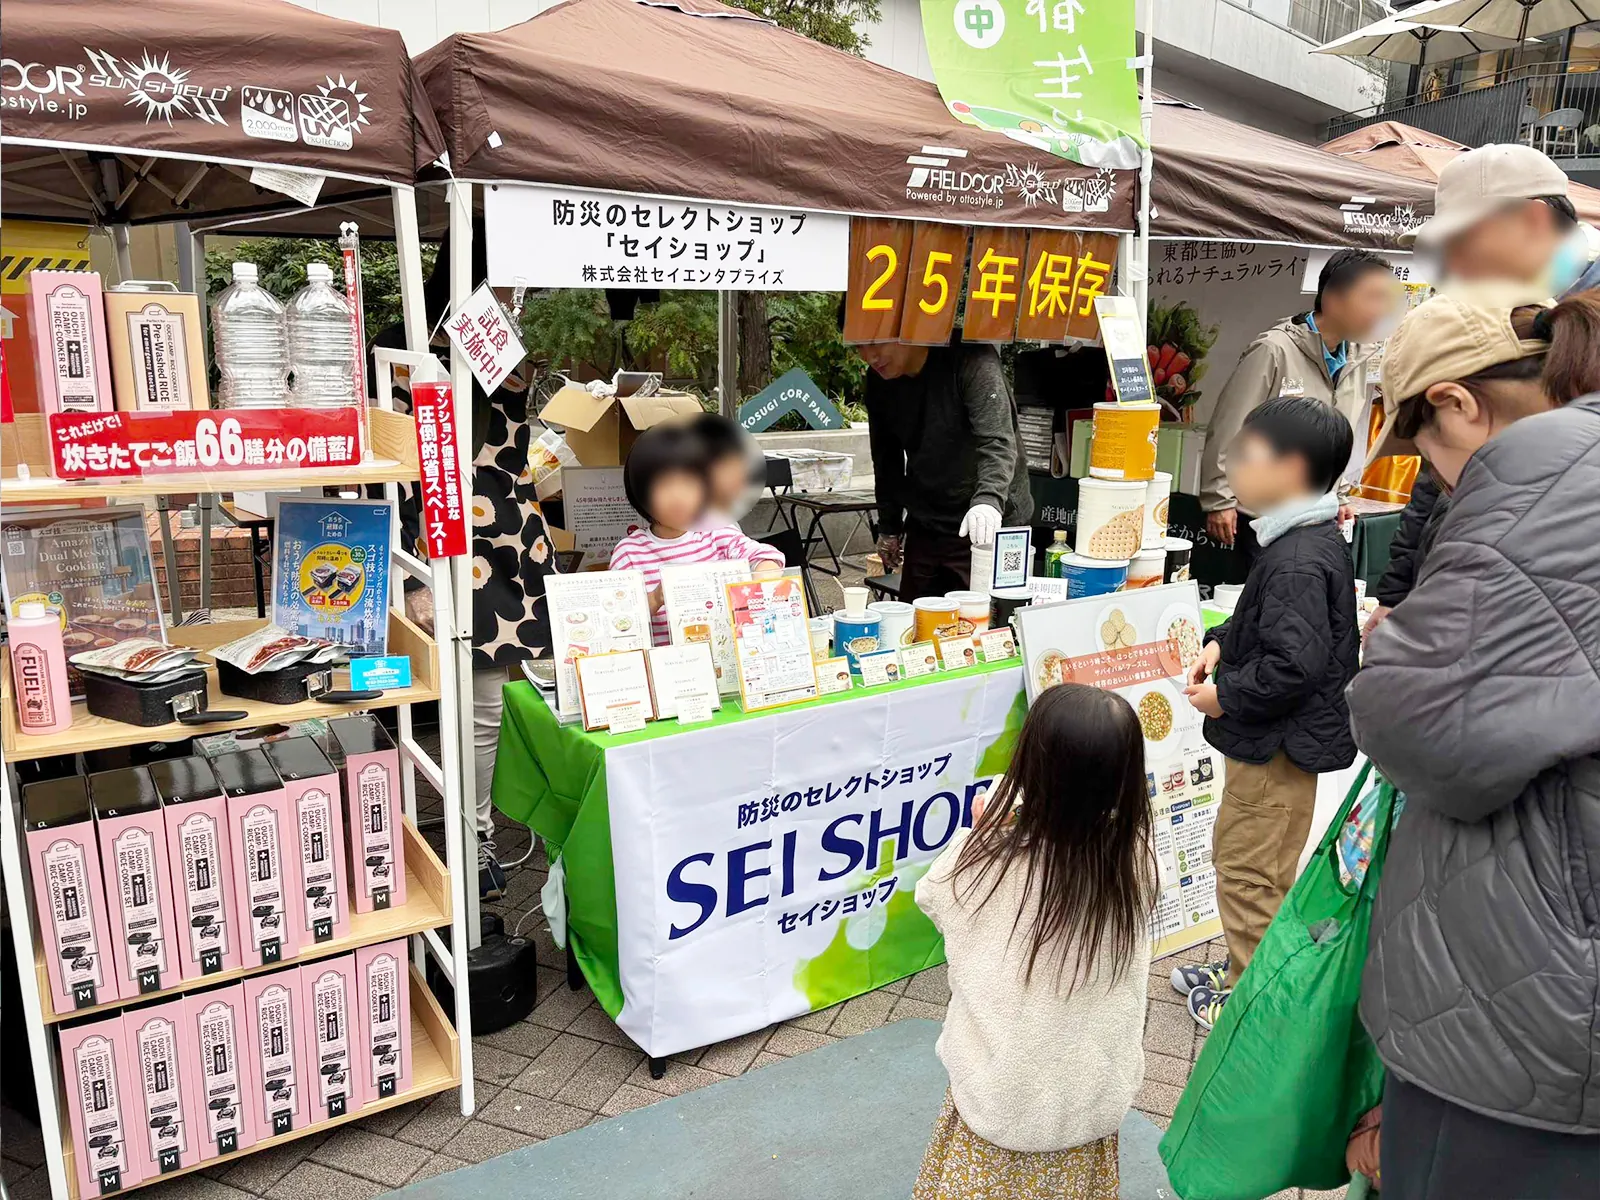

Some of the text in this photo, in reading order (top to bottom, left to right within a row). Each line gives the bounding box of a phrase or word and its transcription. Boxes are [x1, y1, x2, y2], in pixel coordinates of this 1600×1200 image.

[303, 117, 335, 137] UV
[306, 136, 350, 148] PROTECTION
[906, 188, 1004, 208] Powered by ottostyle.jp
[552, 199, 807, 236] 防災のセレクトショップ
[606, 232, 765, 264] 「セイショップ」
[582, 264, 785, 285] 株式会社セイエンタプライズ
[70, 311, 80, 337] OUCHI
[477, 304, 510, 356] 試食
[53, 311, 68, 378] RICE-COOKER SET
[152, 323, 170, 402] Pre-Washed RICE
[741, 388, 832, 430] KOSUGI CORE PARK
[56, 413, 123, 442] これだけで!
[62, 416, 355, 473] 炊きたてご飯66膳分の備蓄!
[434, 384, 461, 520] マンション備蓄に最適な
[416, 405, 448, 557] 圧倒的省スペース!
[50, 536, 105, 549] Amazing
[39, 551, 69, 562] Dual
[55, 560, 106, 574] Cooking
[21, 656, 40, 696] FUEL
[736, 752, 953, 829] 防災のセレクトショップ
[199, 833, 207, 856] OUCHI
[135, 848, 144, 871] OUCHI
[65, 860, 75, 884] OUCHI
[188, 880, 196, 892] SET
[665, 829, 798, 941] SEI
[124, 896, 133, 908] SET
[376, 893, 386, 903] M
[776, 876, 899, 935] セイショップ
[56, 909, 65, 922] SET
[317, 925, 328, 936] M
[265, 945, 276, 956] M
[205, 956, 217, 966] M
[143, 974, 156, 985] M
[78, 989, 91, 1000] M
[382, 1080, 392, 1091] M
[331, 1100, 342, 1111] M
[277, 1117, 288, 1127] M
[221, 1136, 232, 1146] M
[164, 1154, 176, 1165] M
[103, 1175, 116, 1187] M
